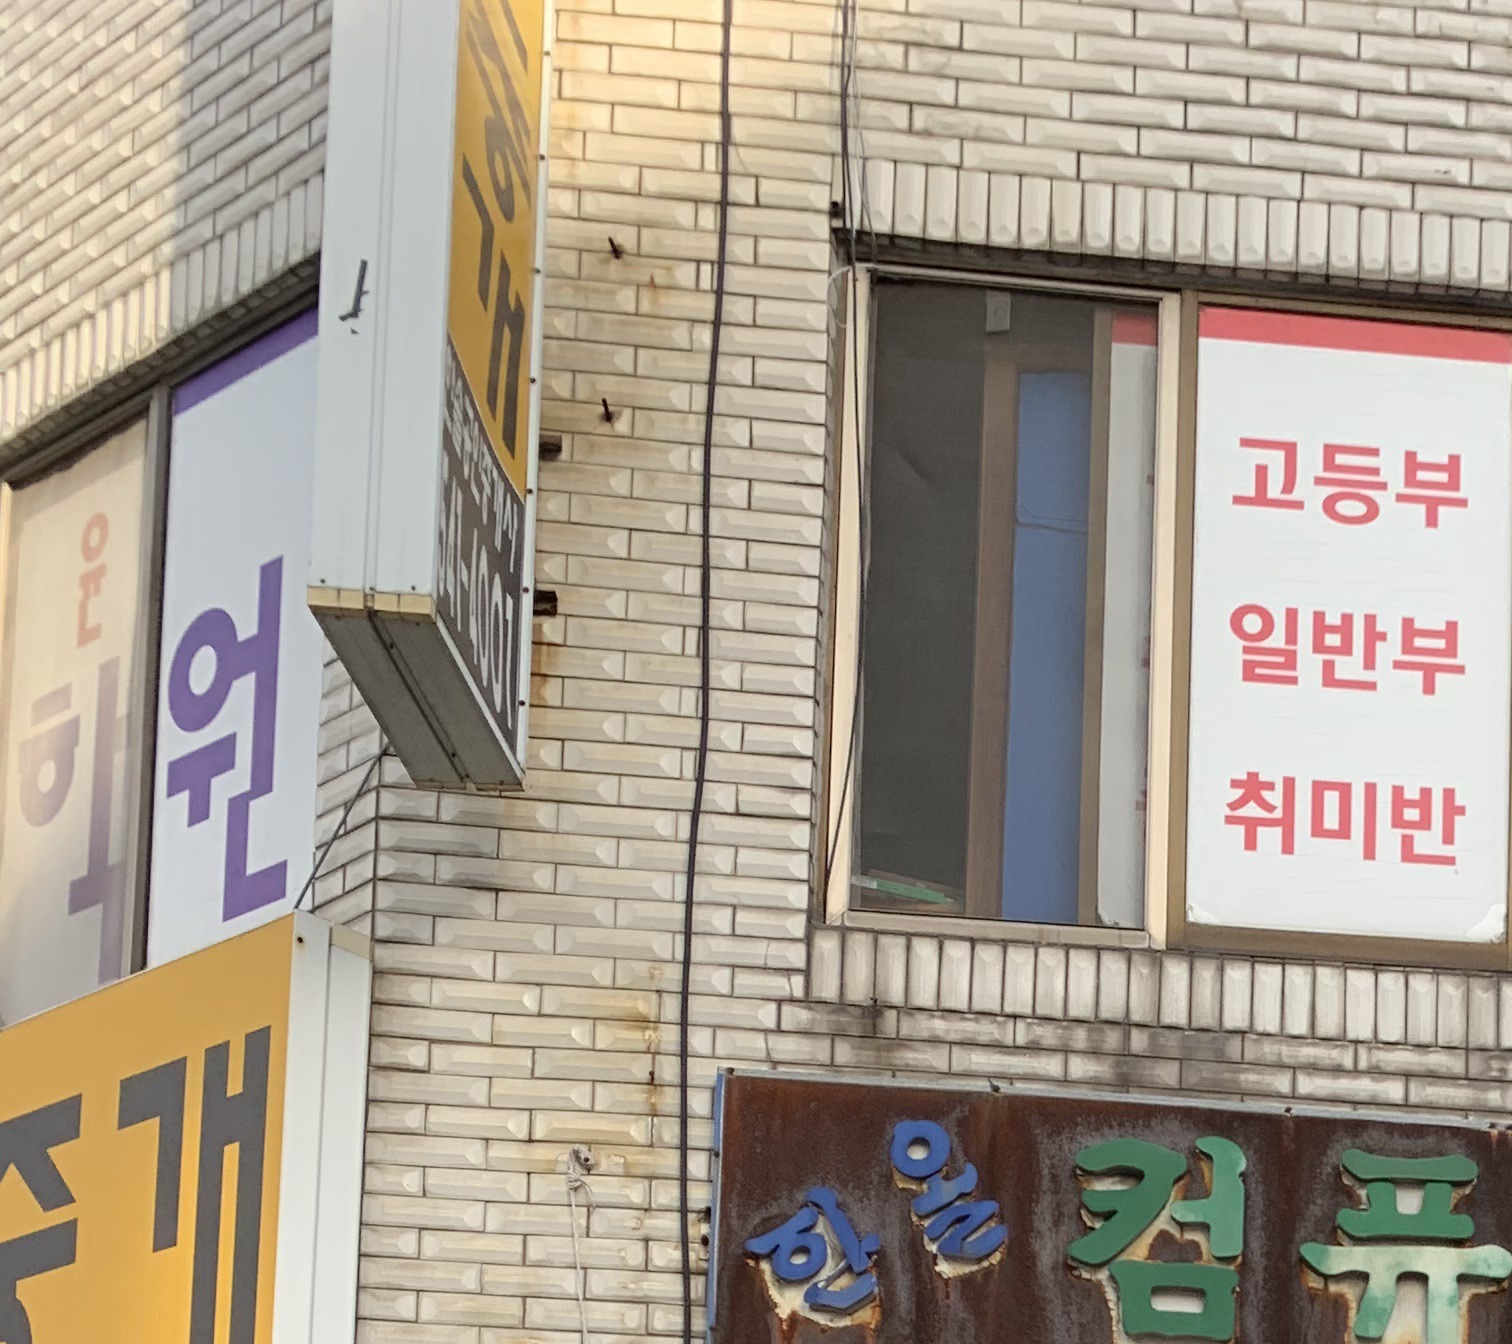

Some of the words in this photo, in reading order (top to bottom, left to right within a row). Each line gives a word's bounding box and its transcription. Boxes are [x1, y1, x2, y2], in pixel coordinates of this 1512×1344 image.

[1231, 437, 1469, 529] 고등부
[1229, 604, 1467, 697] 일반부
[1224, 771, 1467, 867] 취미반
